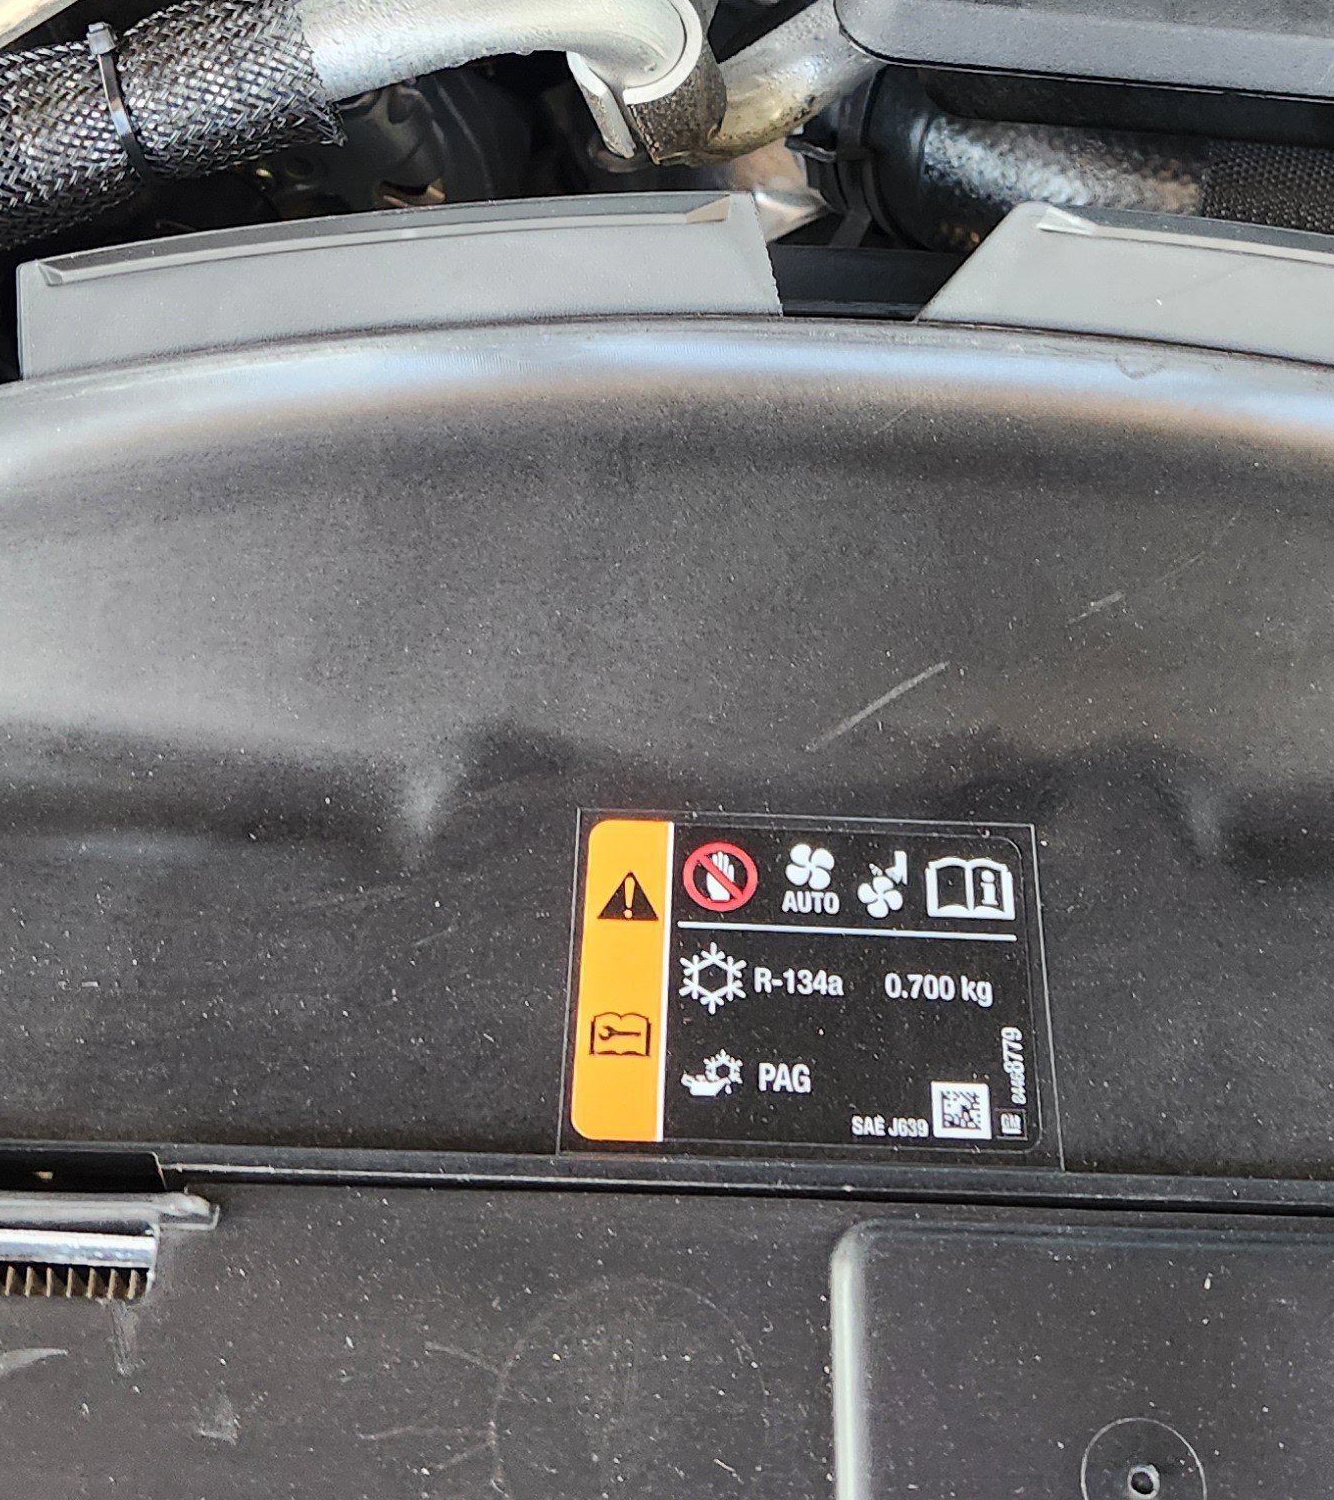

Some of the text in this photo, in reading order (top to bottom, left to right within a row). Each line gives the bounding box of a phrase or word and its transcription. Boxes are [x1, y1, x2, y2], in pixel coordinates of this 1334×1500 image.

[782, 890, 840, 915] AUTO
[754, 967, 994, 1008] R-134a 0.700 kg
[758, 1062, 812, 1094] PAG
[851, 1114, 930, 1138] SAE J639
